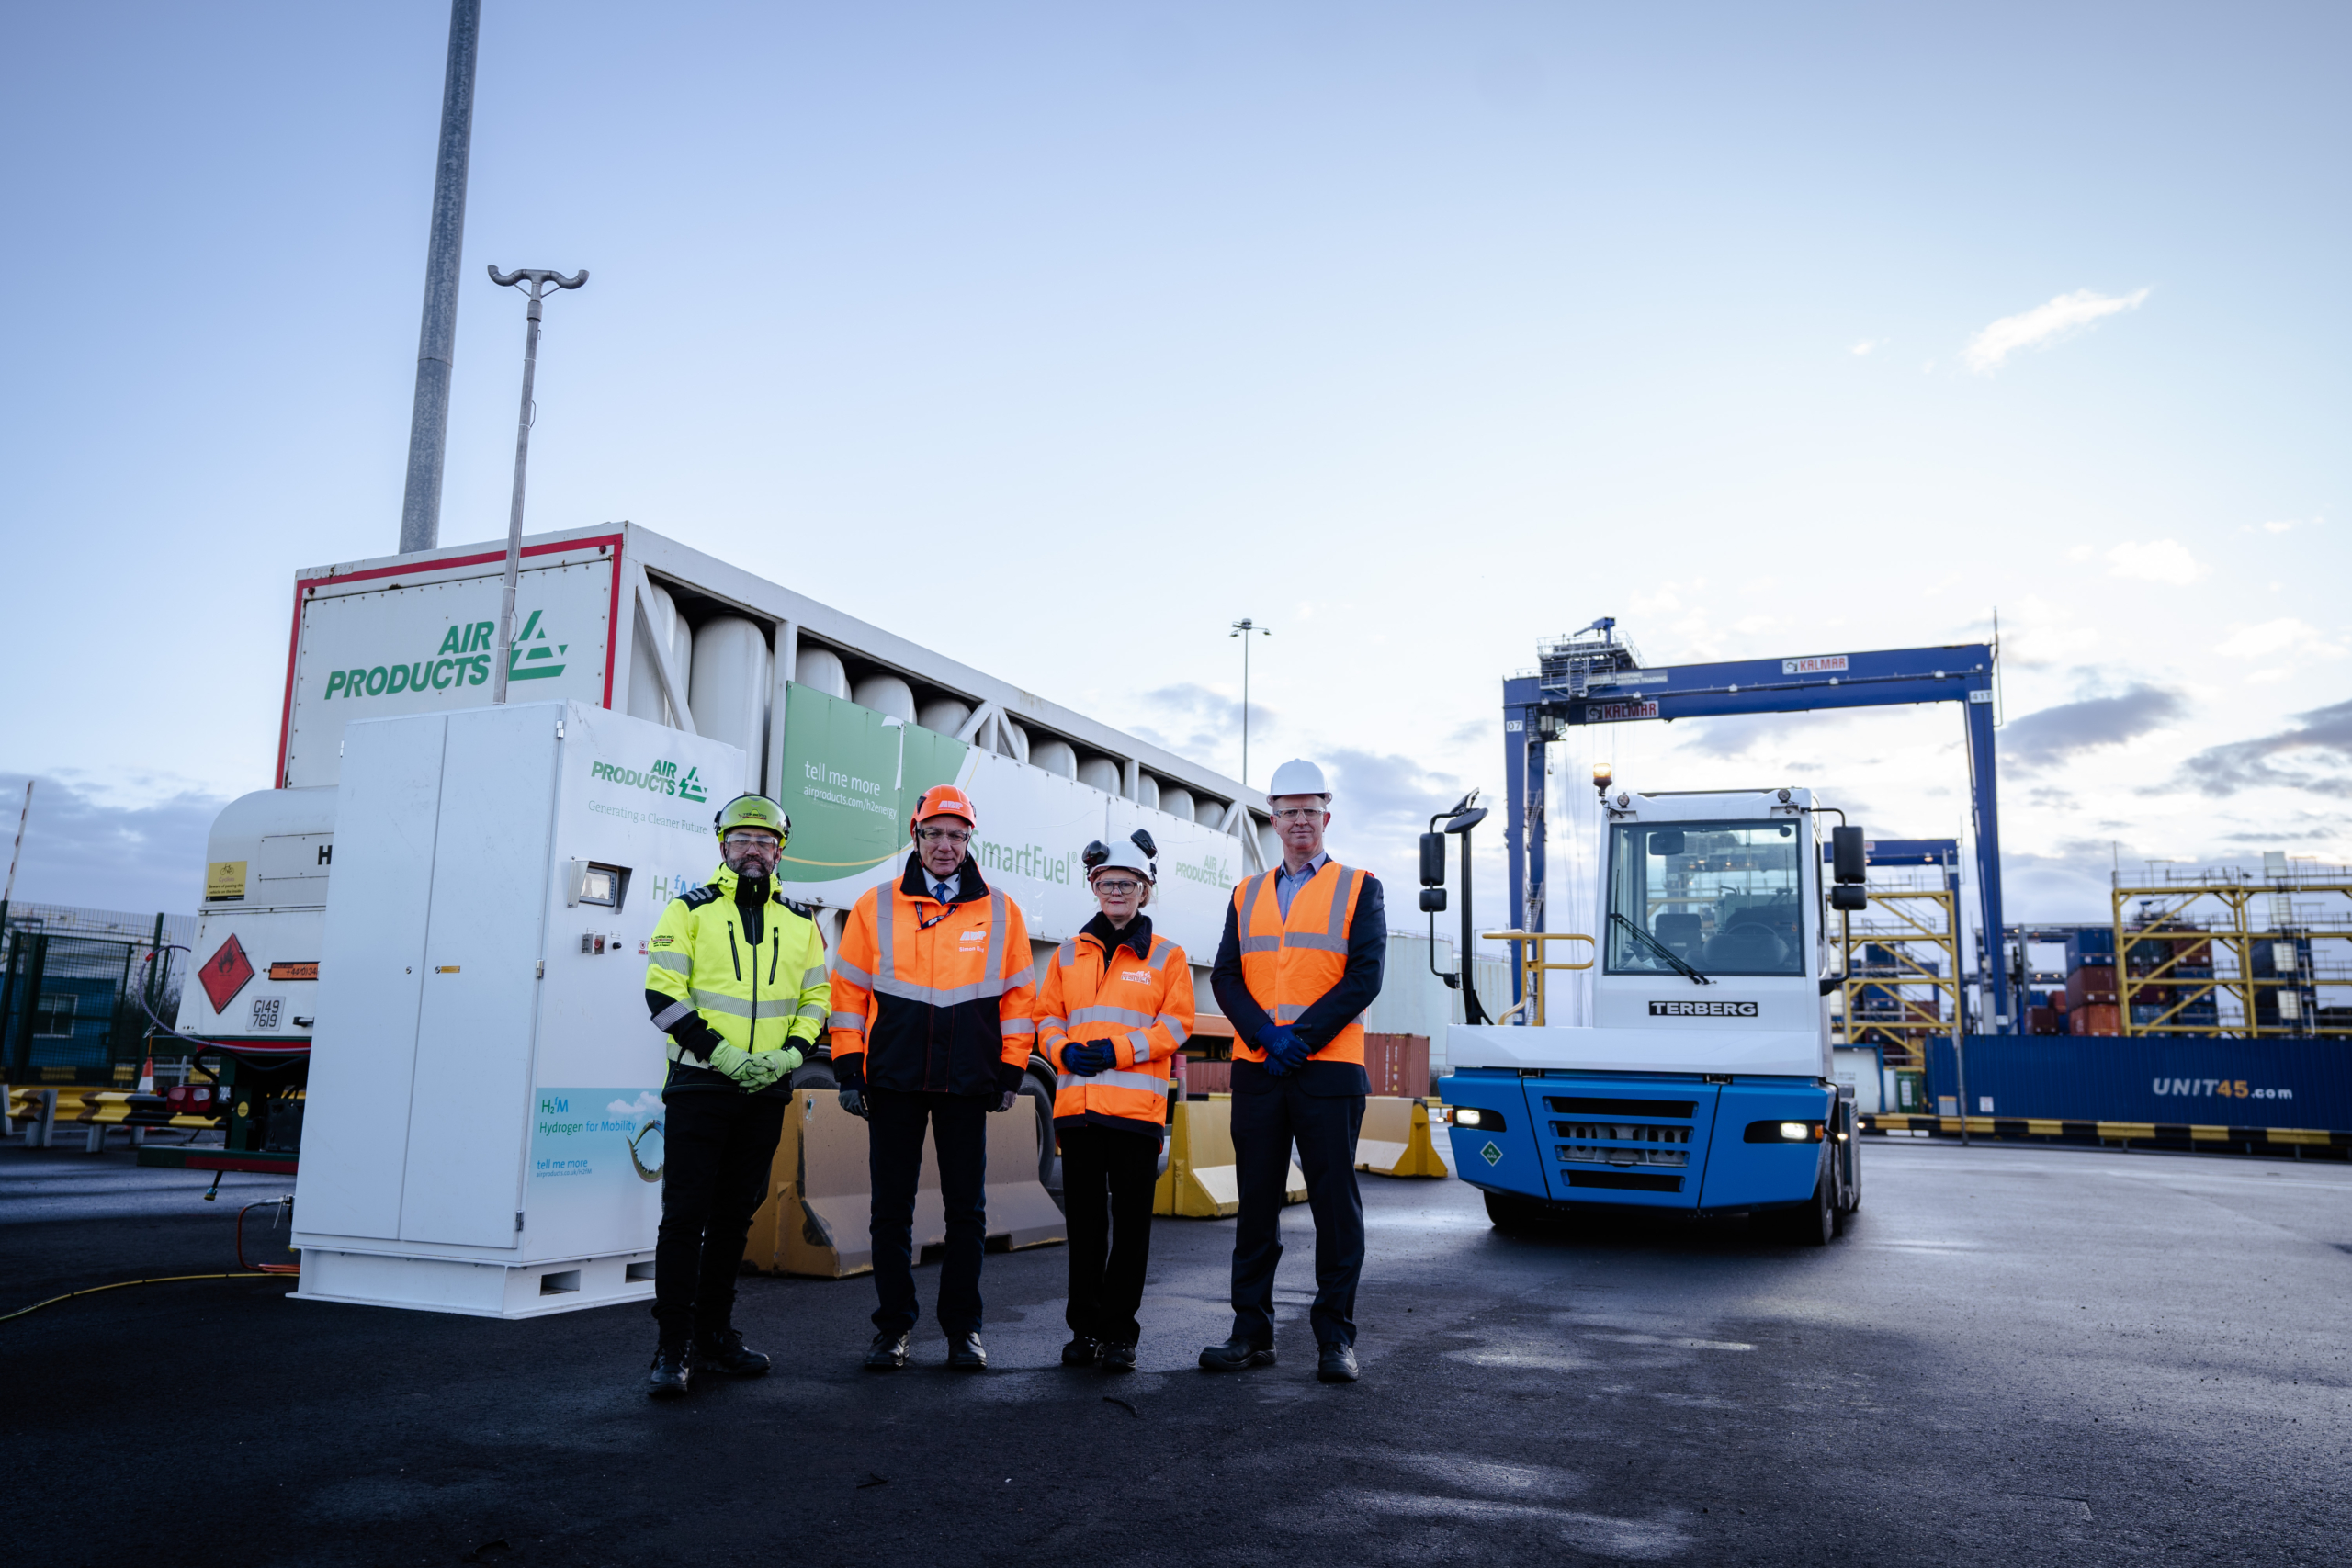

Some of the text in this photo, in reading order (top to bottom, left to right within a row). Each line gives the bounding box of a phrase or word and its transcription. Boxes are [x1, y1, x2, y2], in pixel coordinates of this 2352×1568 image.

[437, 621, 495, 656] AIR
[1799, 658, 1846, 671] KALMAR
[324, 654, 492, 701] PRODUCTS
[1604, 703, 1657, 718] KALMAR
[1508, 721, 1521, 730] 07
[650, 759, 677, 779] AIR
[591, 761, 676, 796] PRODUCTS
[805, 761, 881, 796] tell me more
[804, 785, 897, 820] airproducts.com/h2energy
[937, 800, 963, 809] ABP
[588, 800, 707, 834] Generating a Cleaner Future
[1204, 854, 1217, 872] AIR
[1175, 861, 1217, 886] PRODUCTS
[959, 931, 987, 941] ABP
[1651, 1002, 1757, 1016] TERBERG
[539, 1120, 637, 1137] Hydrogen for Mobility
[537, 1158, 588, 1170] tell me more
